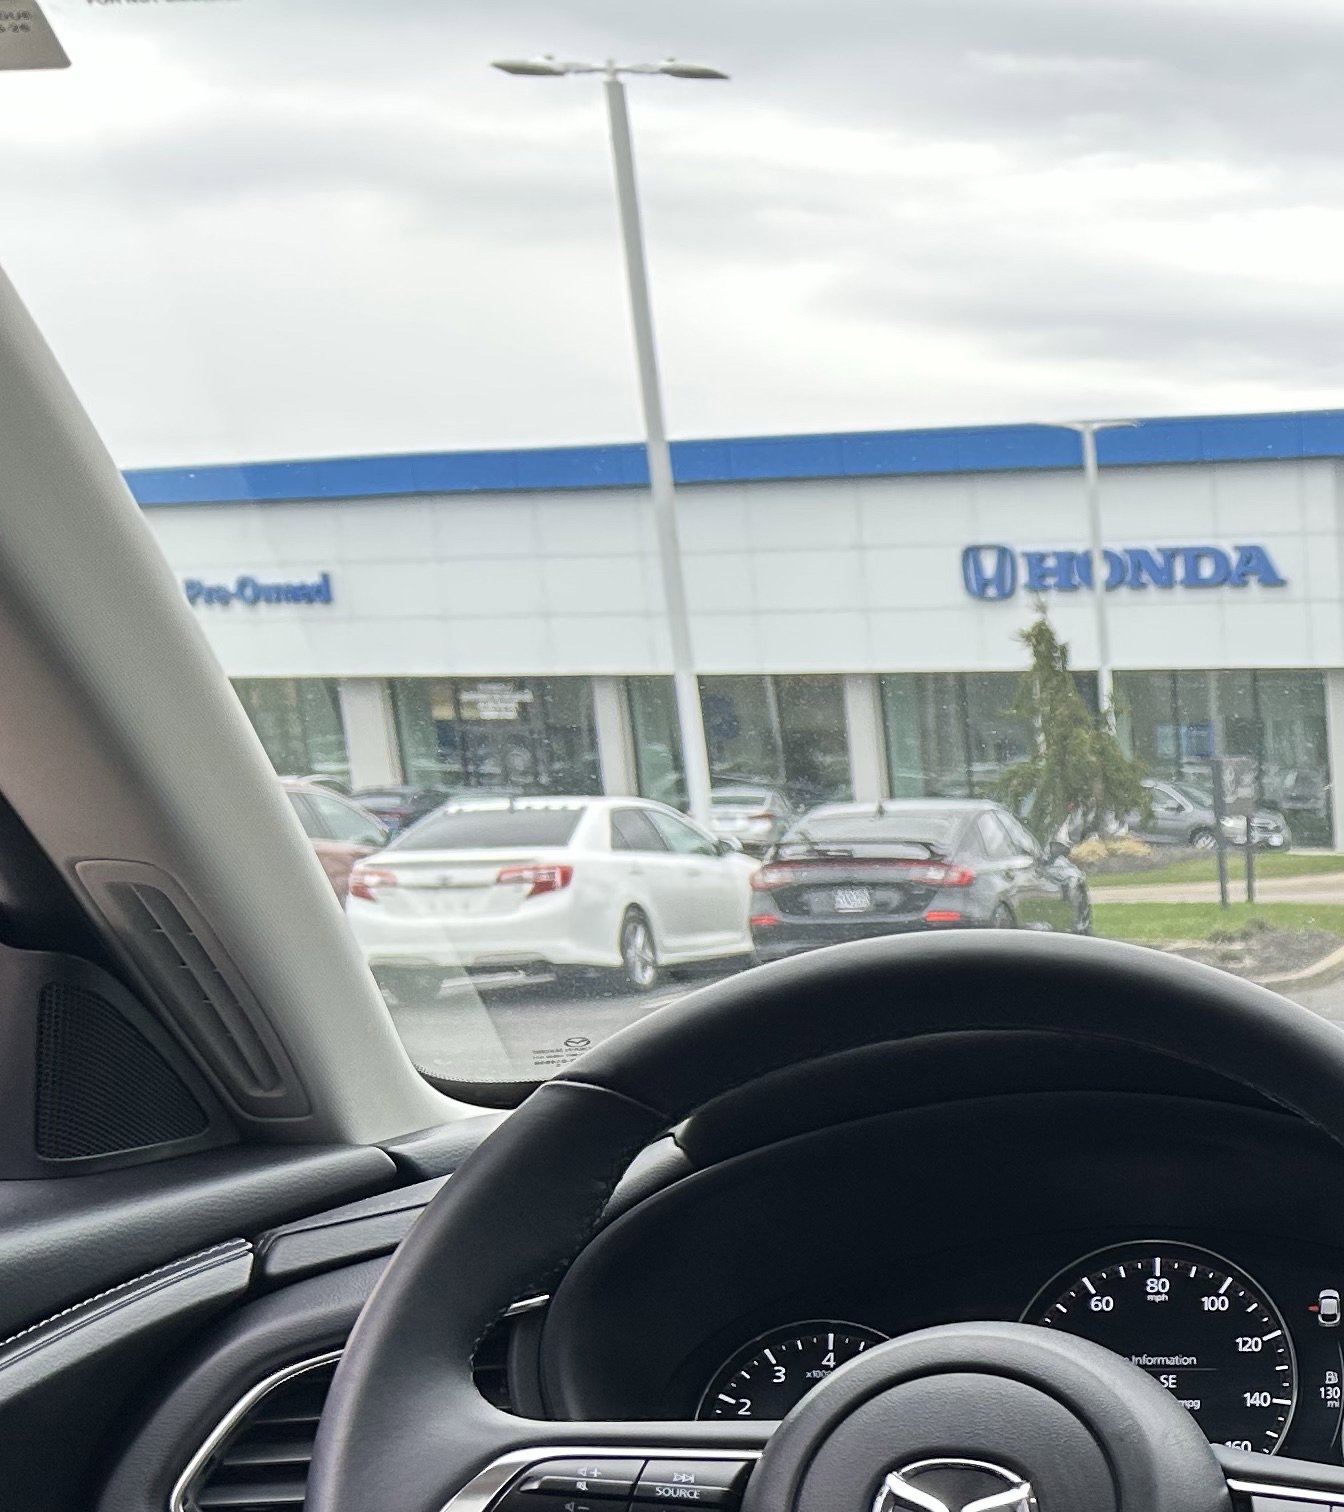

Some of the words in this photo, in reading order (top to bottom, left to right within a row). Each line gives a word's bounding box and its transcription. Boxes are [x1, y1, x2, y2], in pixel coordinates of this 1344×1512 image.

[1021, 546, 1287, 591] HONDA
[1145, 1278, 1170, 1293] 80
[1090, 1296, 1115, 1312] 60
[1146, 1294, 1169, 1304] mph
[1201, 1296, 1229, 1311] 100
[1235, 1337, 1262, 1352] 120
[821, 1352, 837, 1368] 4
[1131, 1354, 1198, 1366] Information
[772, 1366, 786, 1383] 3
[1160, 1374, 1177, 1389] SE
[1243, 1391, 1271, 1407] 140
[1319, 1387, 1341, 1399] 130
[737, 1398, 751, 1416] 2
[1326, 1399, 1340, 1408] mi
[655, 1486, 701, 1499] SOURCE
